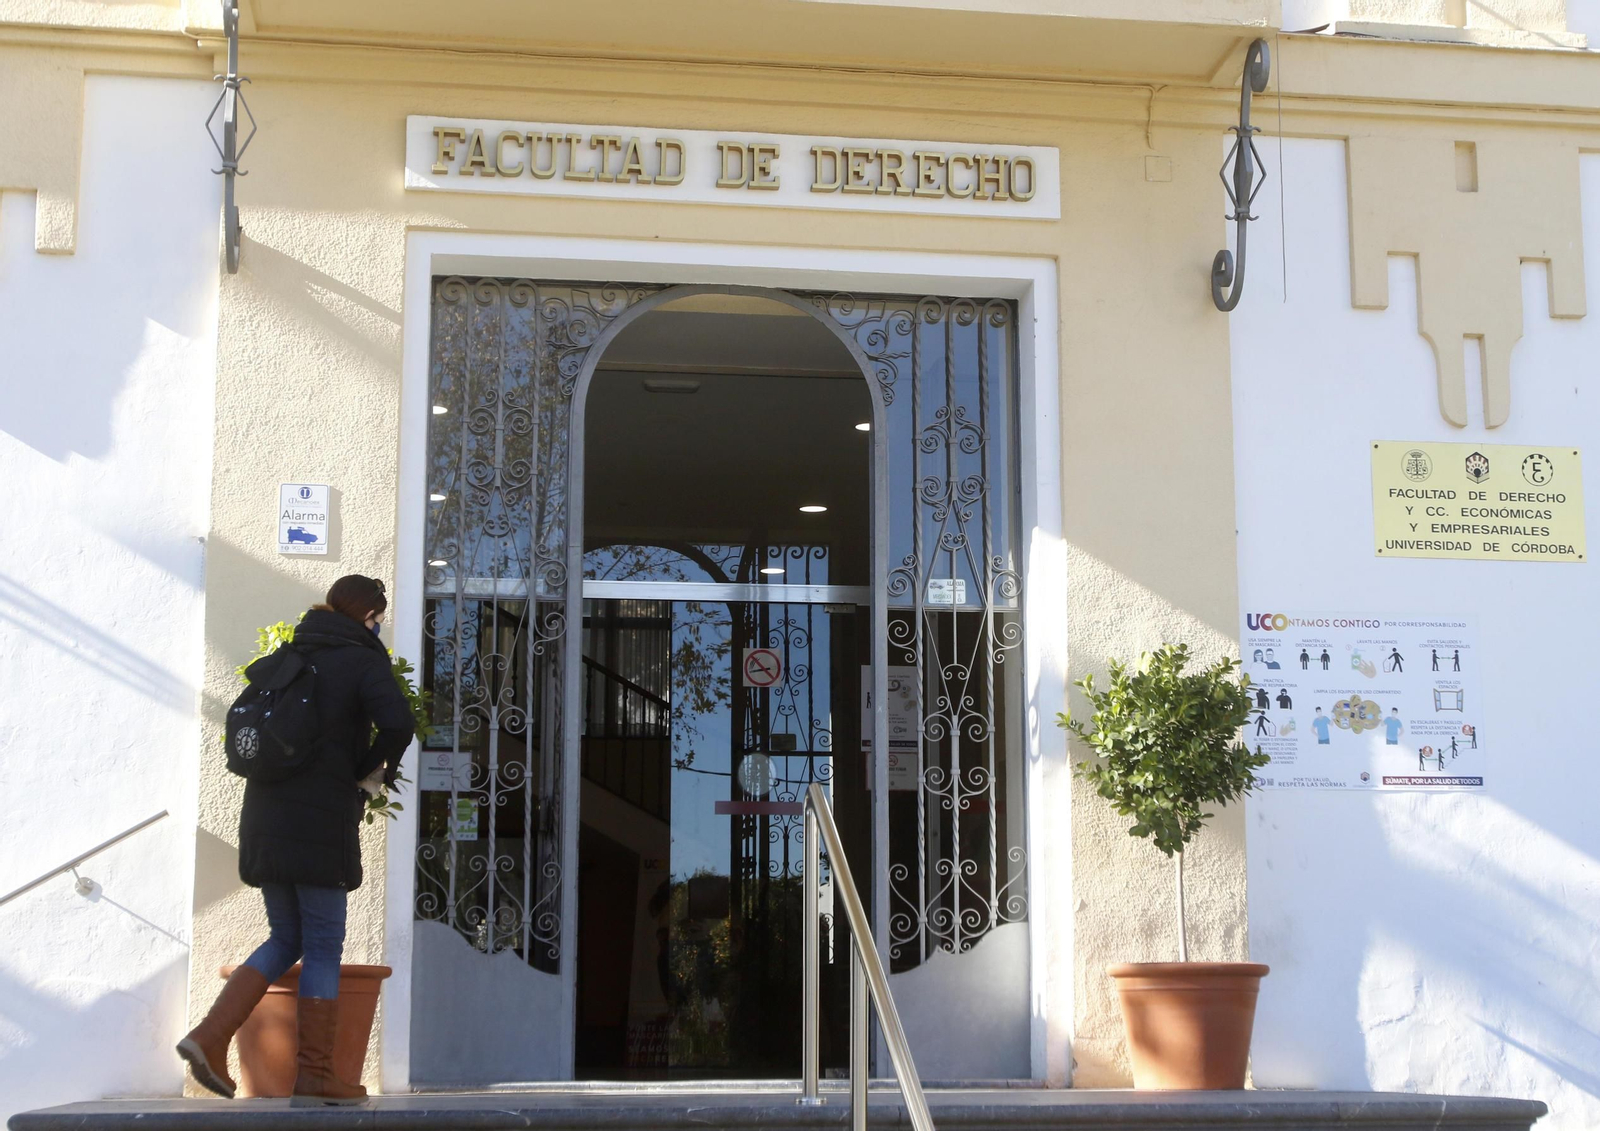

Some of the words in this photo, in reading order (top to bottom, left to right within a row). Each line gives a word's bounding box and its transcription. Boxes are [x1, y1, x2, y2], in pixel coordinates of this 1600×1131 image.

[432, 126, 687, 186] FACULTAD
[715, 140, 780, 190] DE
[808, 144, 1038, 202] DERECHO
[1388, 488, 1456, 500] FACULTAD
[1468, 491, 1487, 500] DE
[1499, 492, 1566, 503] DERECHO
[281, 509, 325, 521] Alarma
[1405, 506, 1414, 515] Y
[1426, 506, 1449, 517] CC.
[1461, 506, 1552, 520] ECONÓMICAS
[1409, 523, 1418, 532] Y
[1431, 523, 1550, 536] EMPRESARIALES
[1386, 540, 1472, 551] UNIVERSIDAD
[1483, 542, 1500, 552] DE
[1511, 541, 1576, 554] CÓRDOBA
[1333, 619, 1380, 628] CONTIGO
[1385, 777, 1411, 785] SÚMATE,
